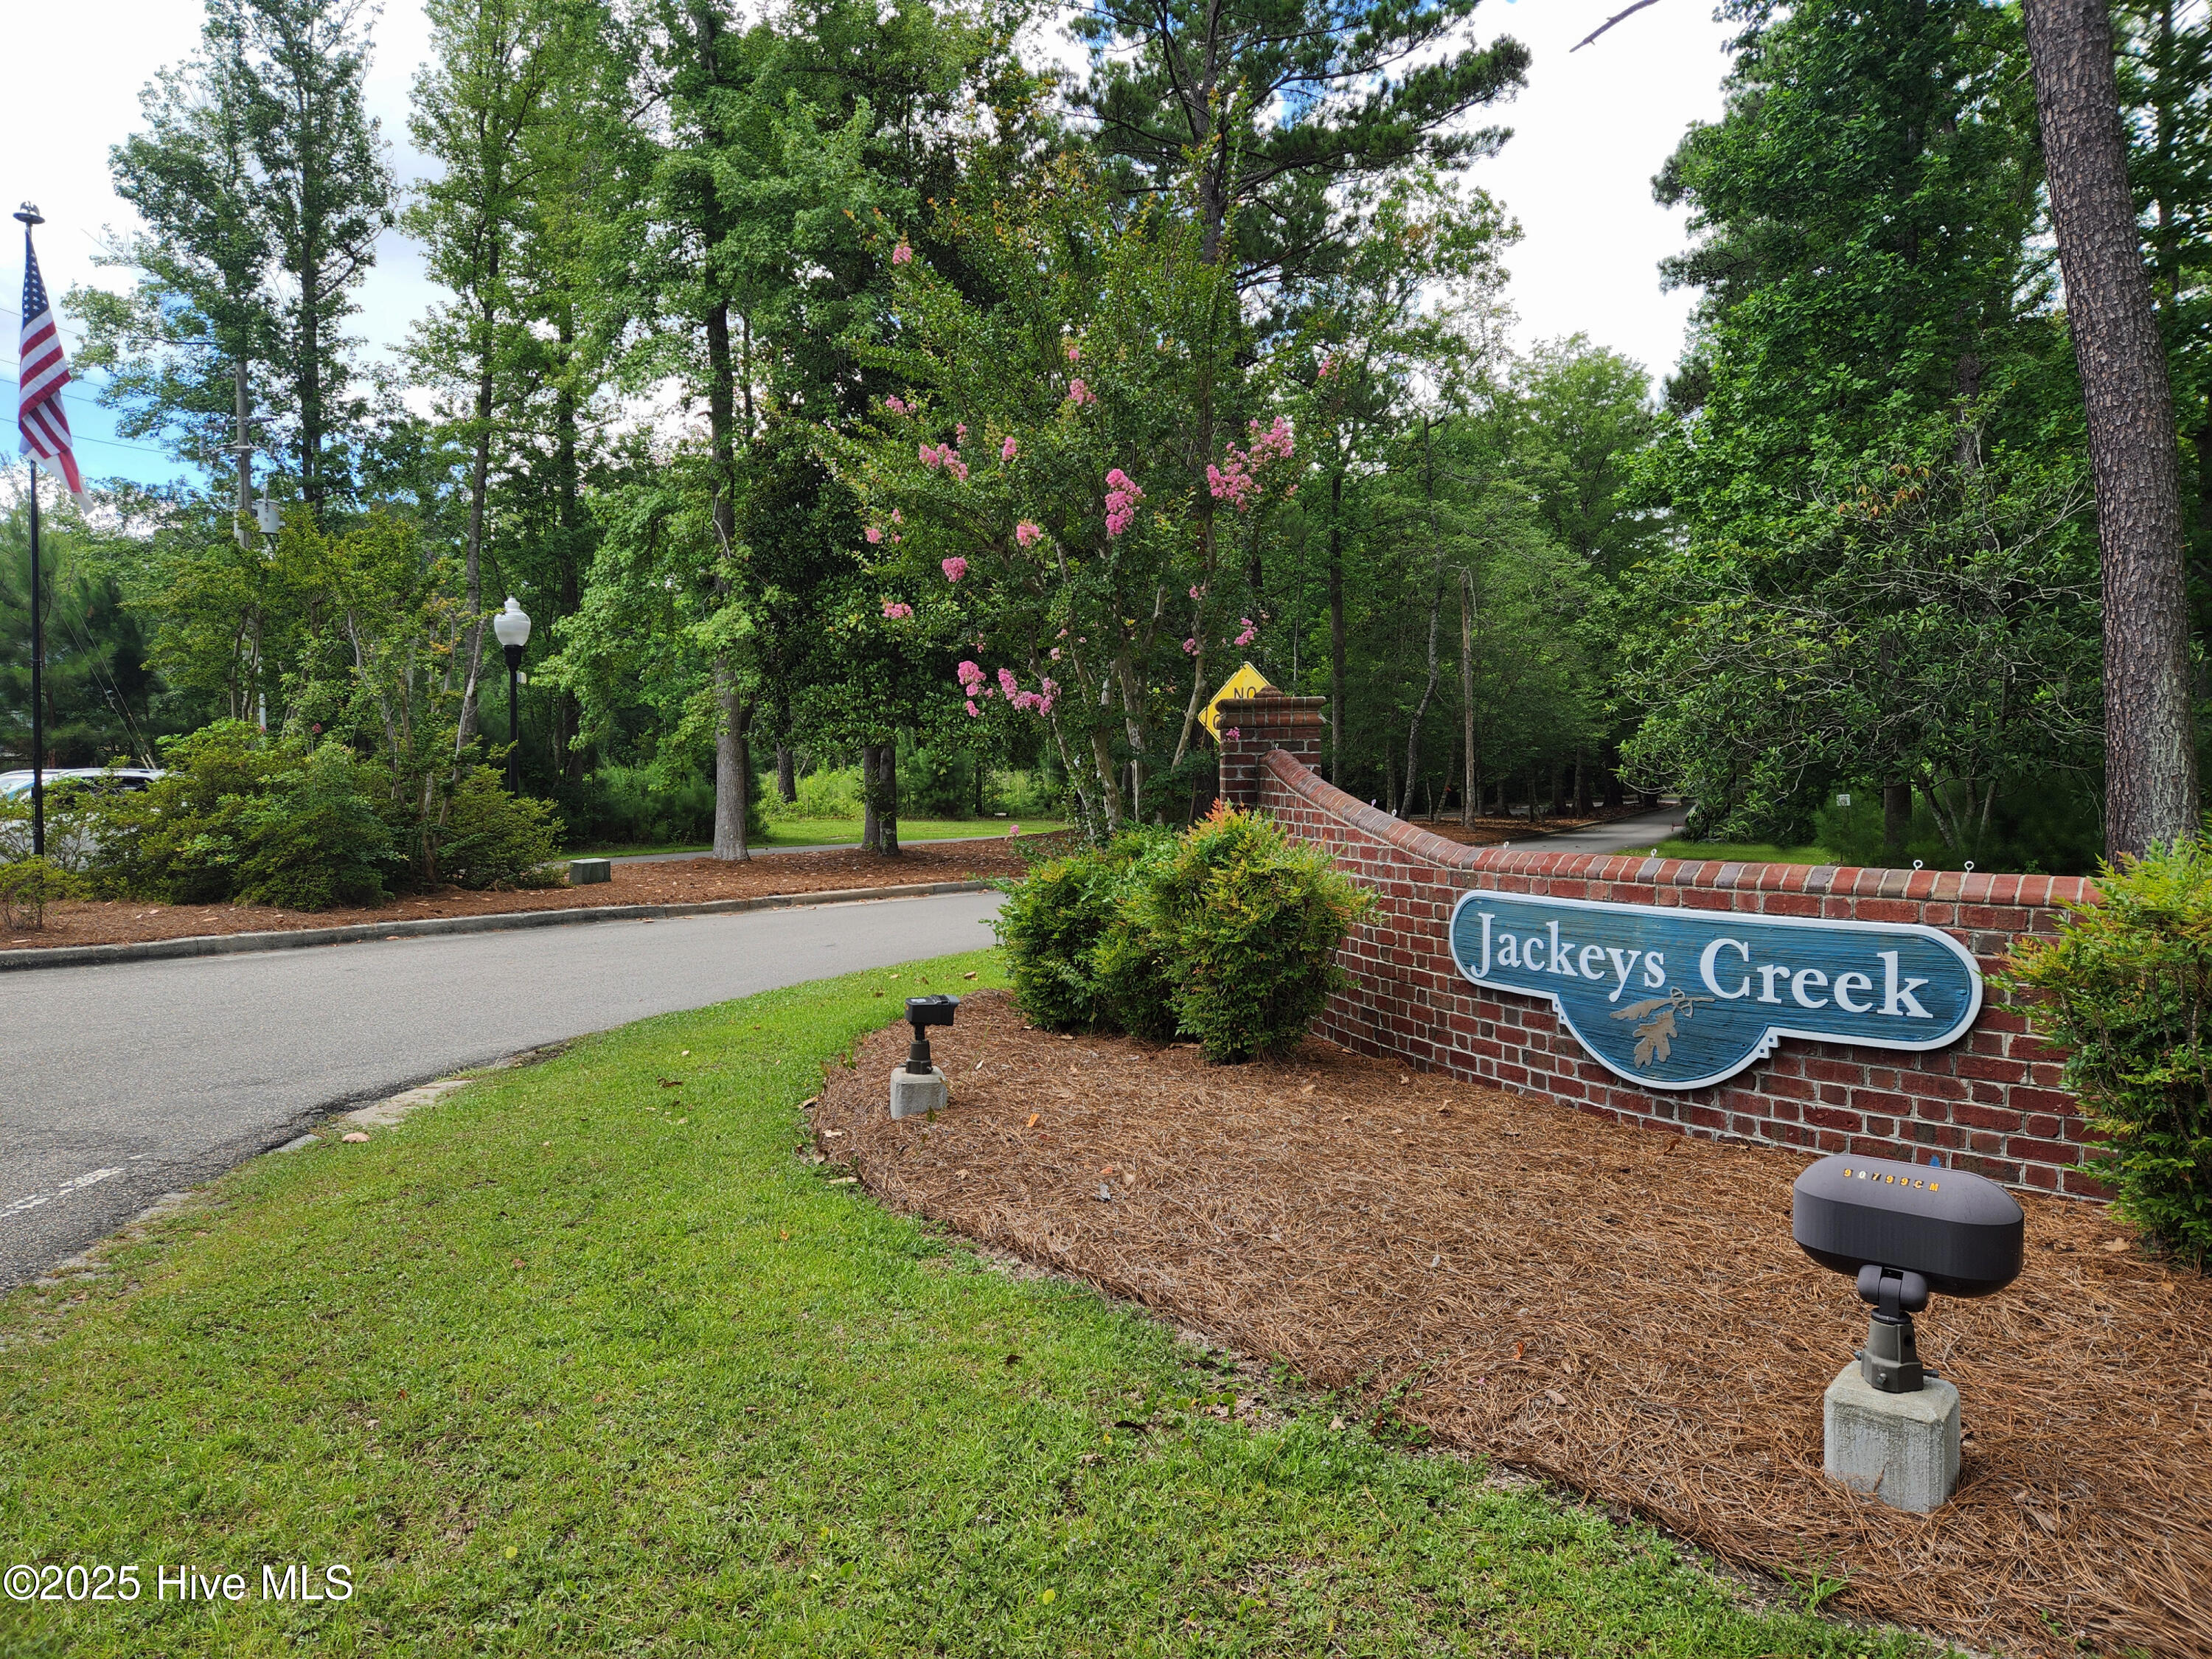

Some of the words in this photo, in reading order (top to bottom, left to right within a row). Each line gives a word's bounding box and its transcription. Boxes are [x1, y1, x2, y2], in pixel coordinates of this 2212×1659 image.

[1234, 686, 1256, 699] NO
[1470, 912, 1666, 1001] Jackeys
[1700, 938, 1933, 1018] Creek
